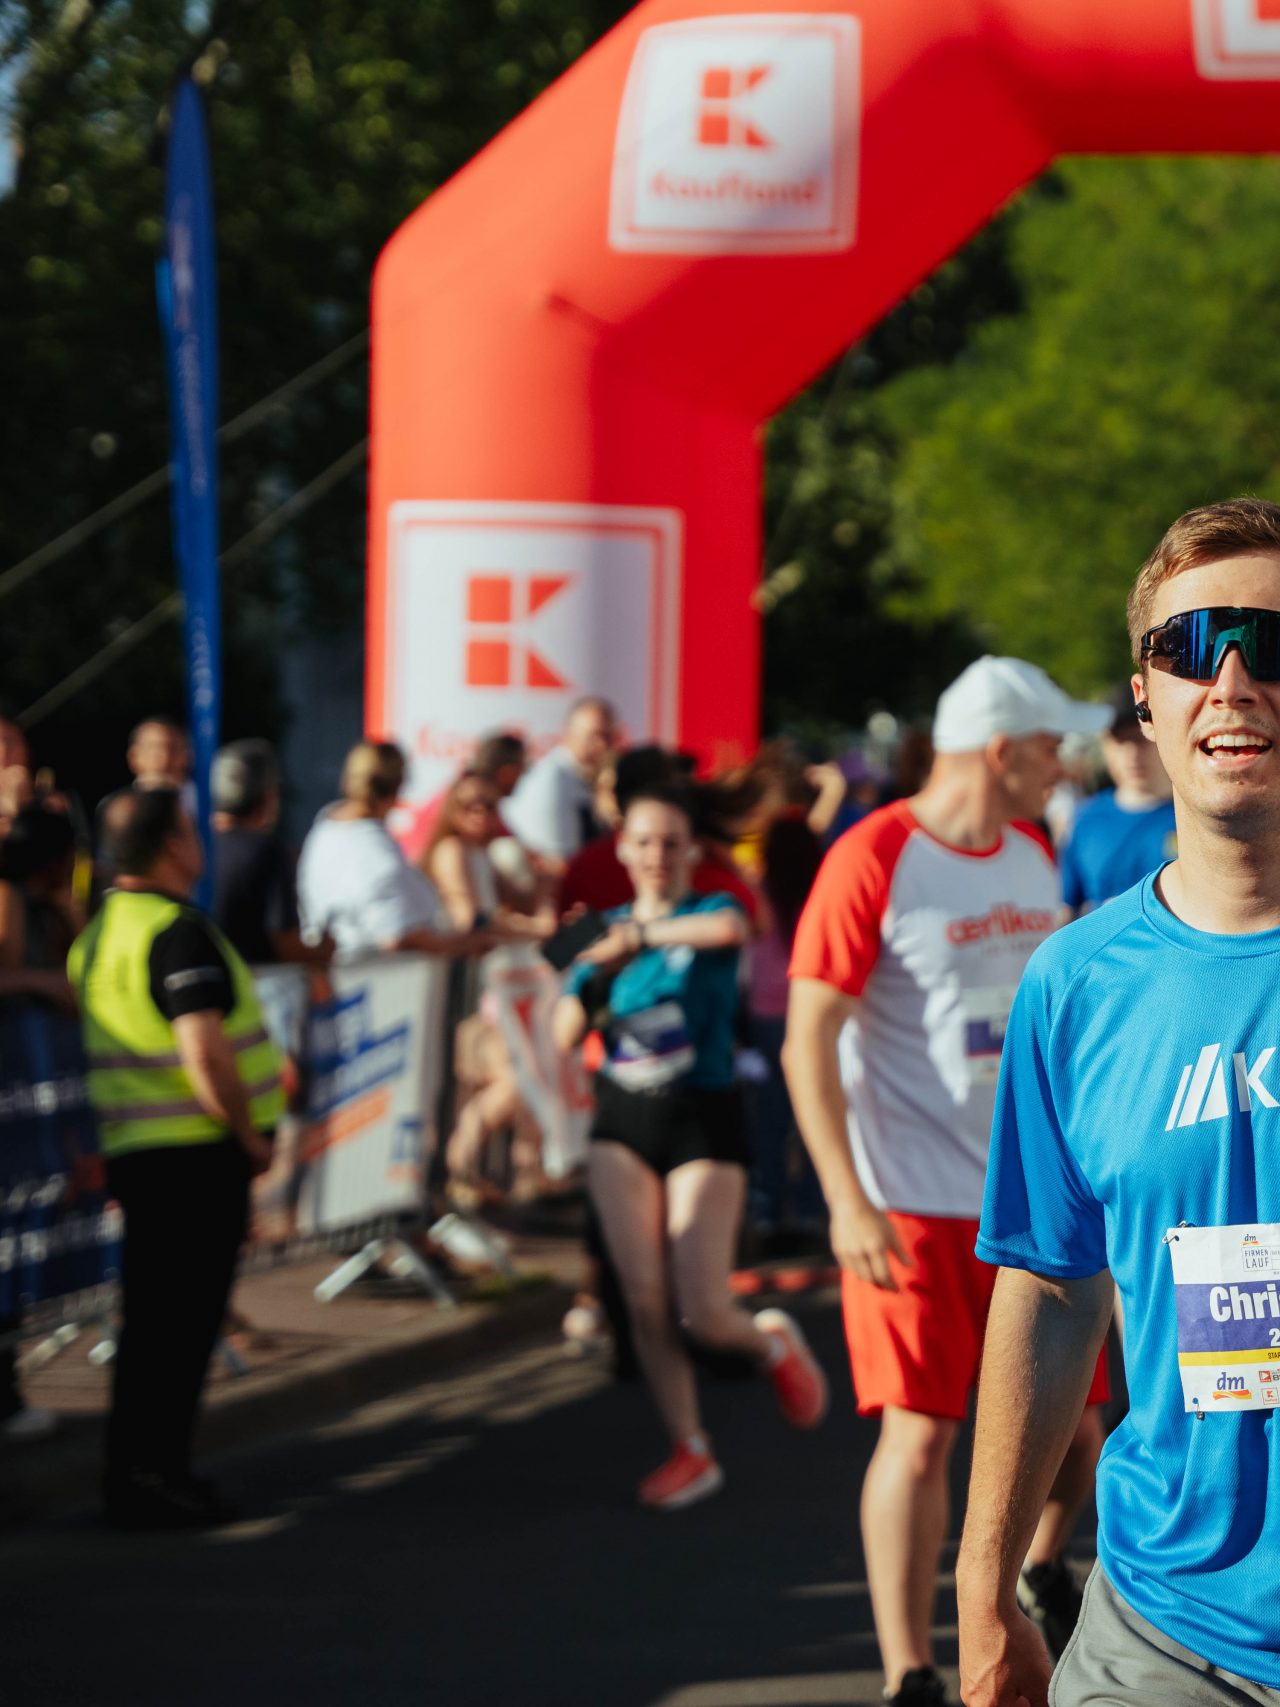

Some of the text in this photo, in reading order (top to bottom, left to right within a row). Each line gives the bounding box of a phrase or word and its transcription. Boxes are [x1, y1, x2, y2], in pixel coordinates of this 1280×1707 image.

[1244, 1233, 1257, 1242] dm
[1244, 1249, 1269, 1257] FIRMEN
[1245, 1258, 1270, 1269] LAUF
[1216, 1371, 1245, 1391] dm
